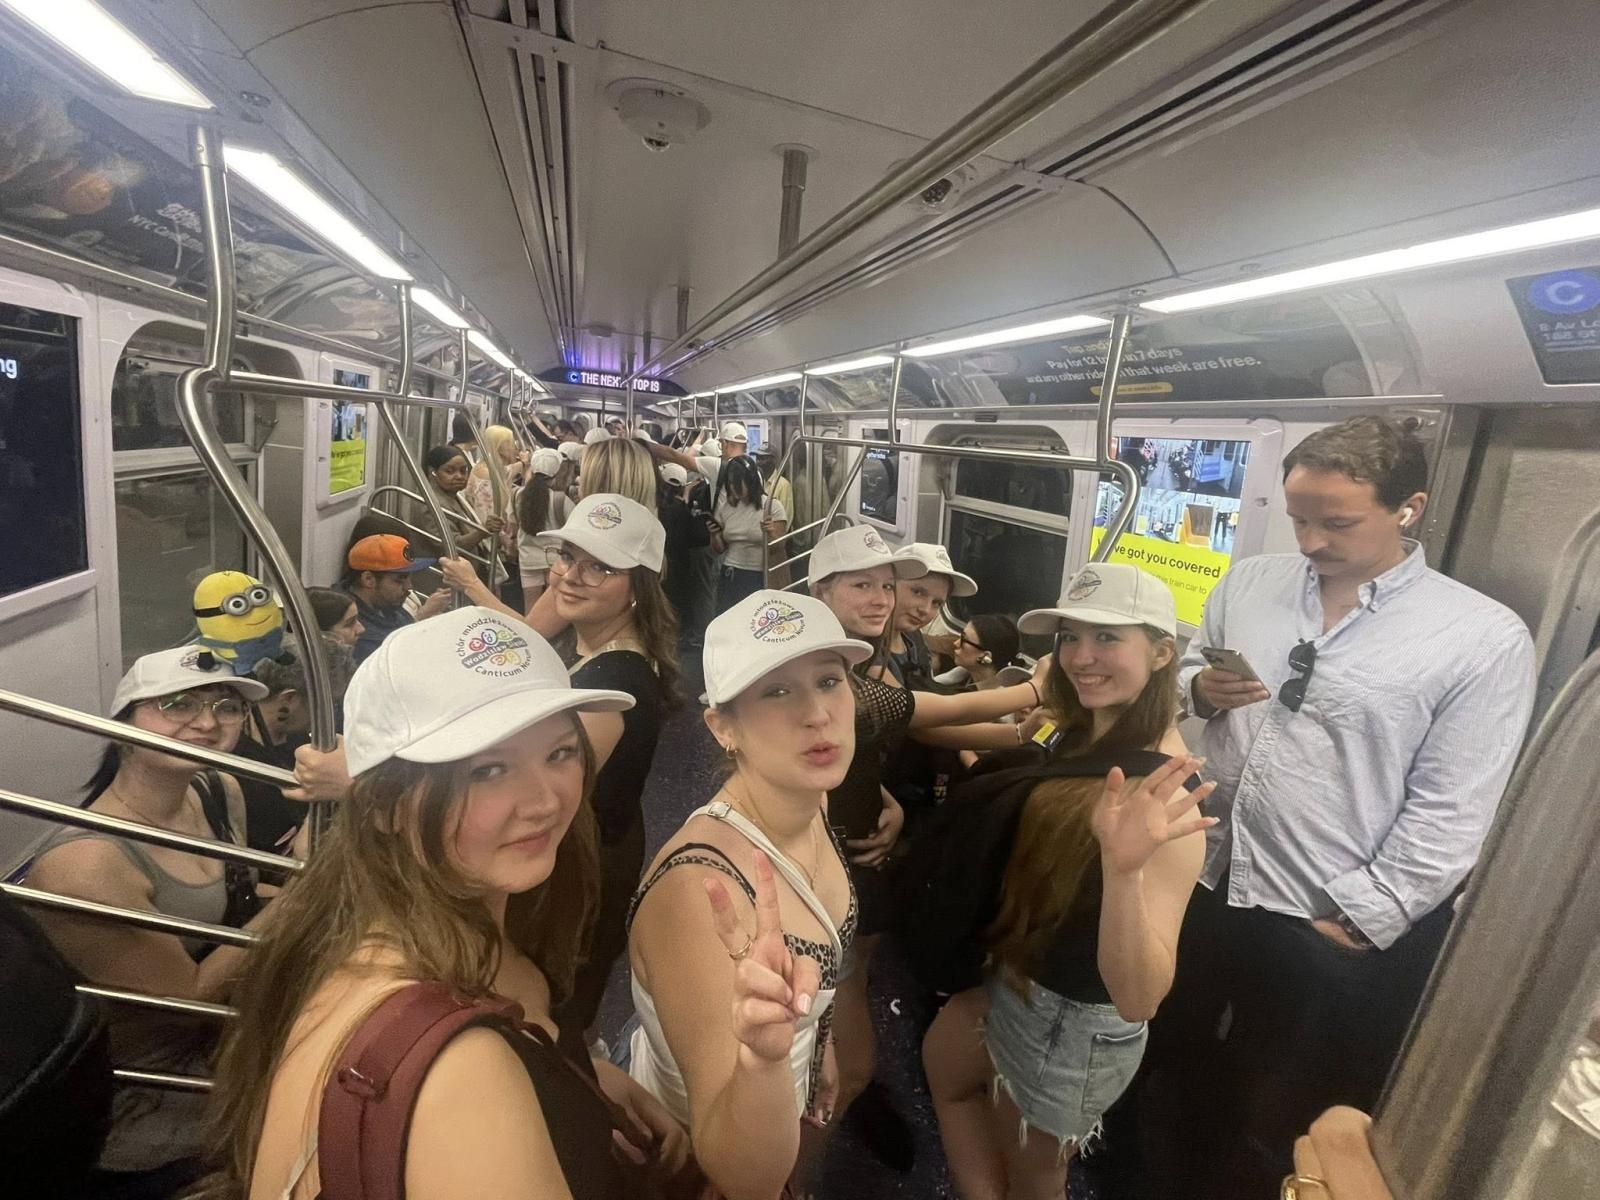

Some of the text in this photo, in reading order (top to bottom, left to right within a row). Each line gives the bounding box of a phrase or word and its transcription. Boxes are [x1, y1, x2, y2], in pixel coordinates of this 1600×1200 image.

[1545, 280, 1584, 305] C
[1046, 359, 1068, 370] Pay
[1082, 355, 1098, 366] 12
[1134, 350, 1145, 361] 7
[1147, 347, 1183, 360] days
[1059, 371, 1085, 381] other
[1124, 365, 1153, 377] that
[1152, 361, 1193, 374] week
[1192, 360, 1219, 371] are
[1218, 355, 1262, 369] free.
[580, 371, 600, 385] THE
[1127, 549, 1222, 579] got you covered
[1169, 577, 1185, 588] train
[1185, 583, 1199, 592] car
[1199, 585, 1207, 595] to
[475, 665, 523, 678] Canticum
